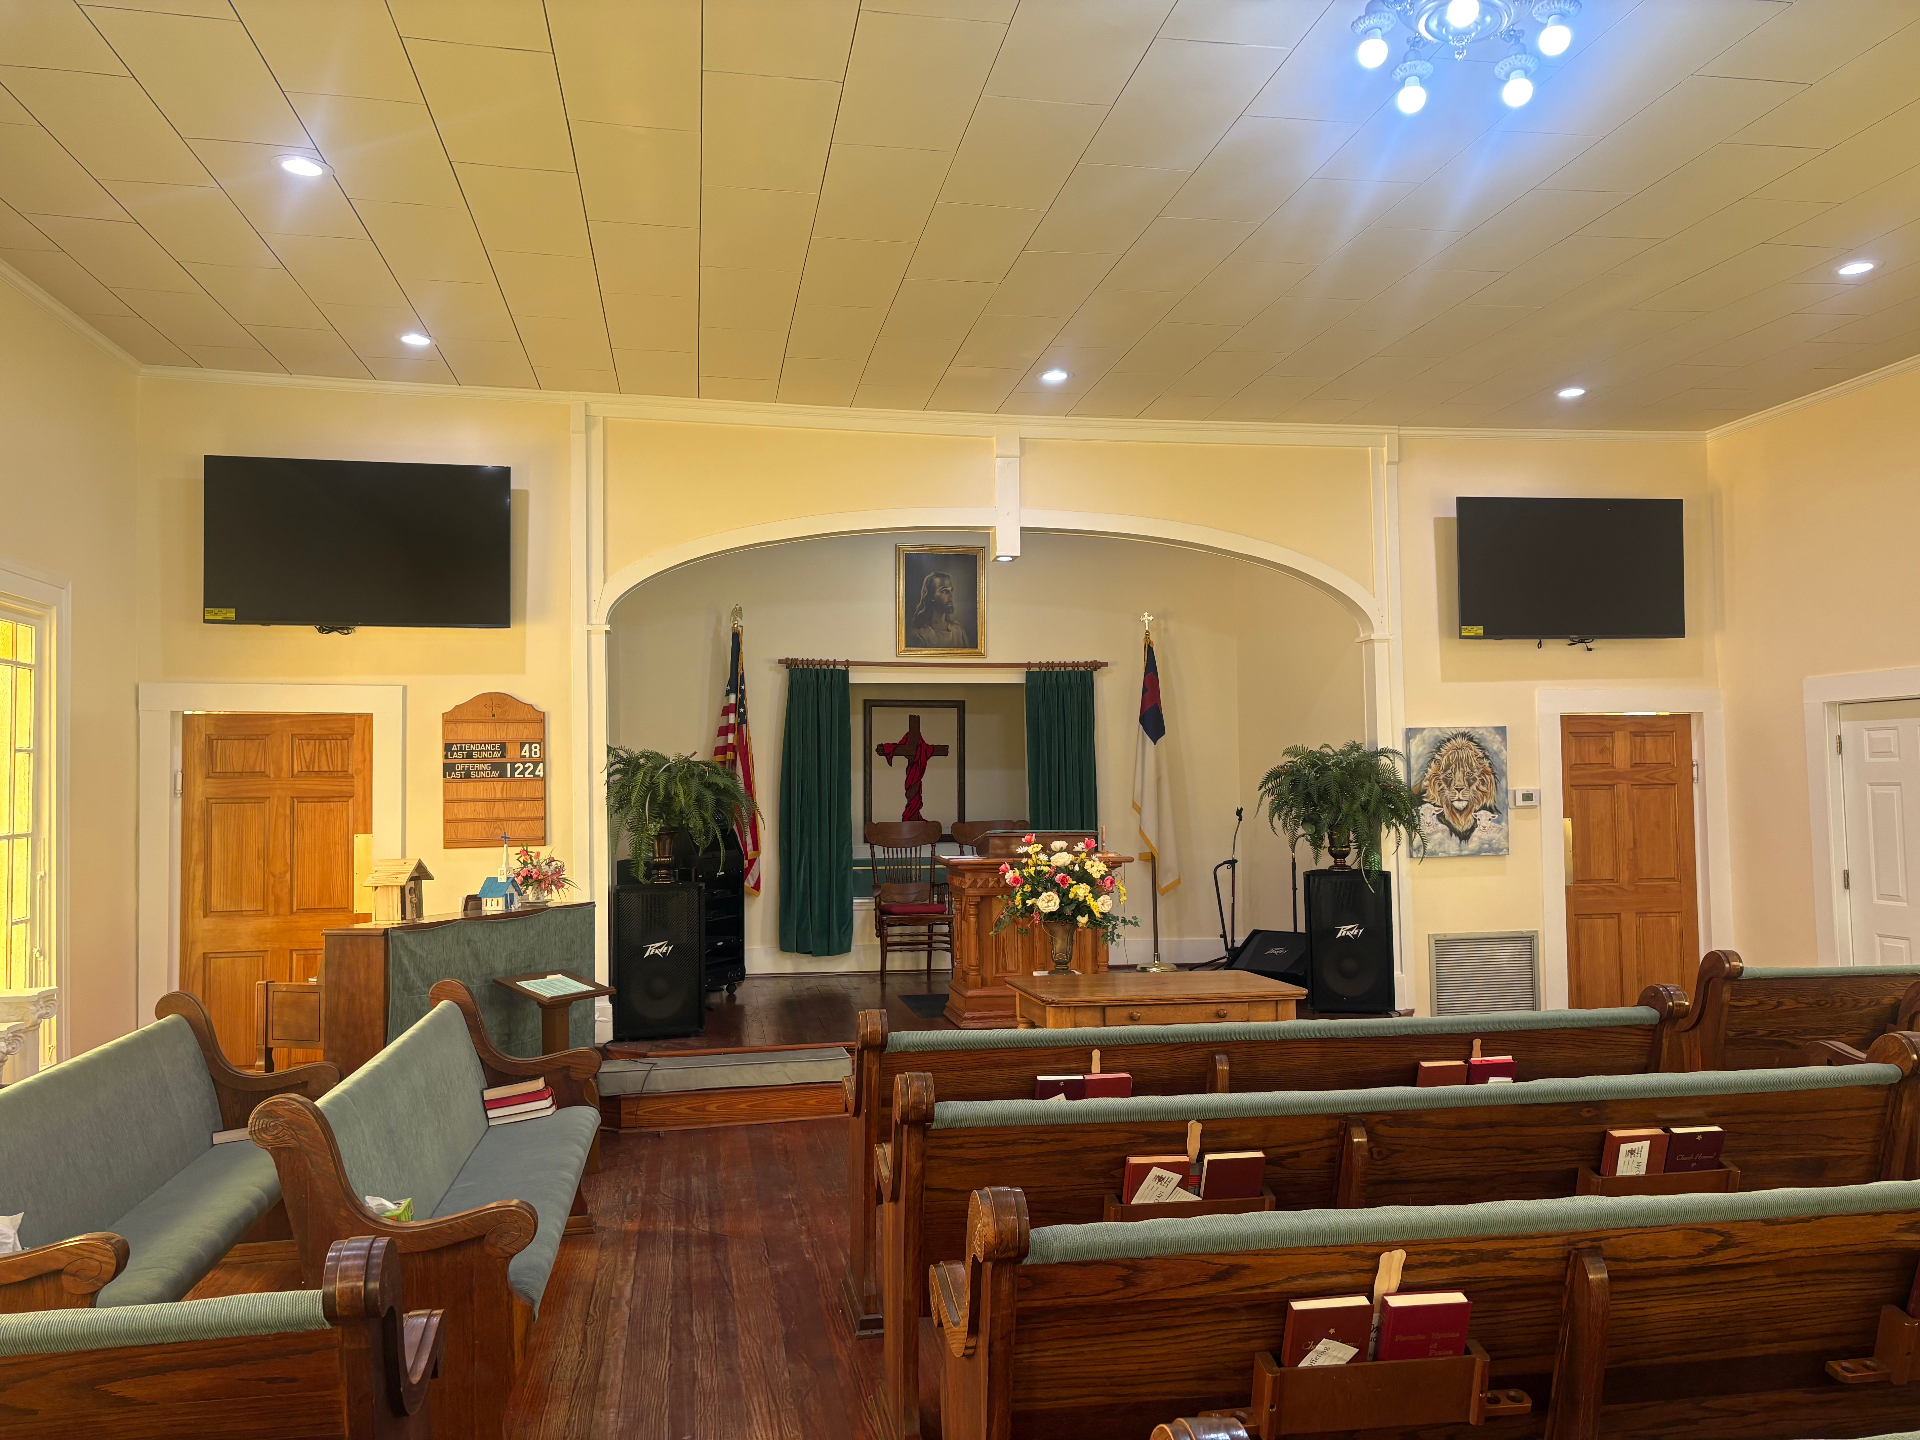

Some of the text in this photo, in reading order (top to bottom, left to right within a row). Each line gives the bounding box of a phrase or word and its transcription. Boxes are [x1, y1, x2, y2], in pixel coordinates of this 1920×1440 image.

[452, 743, 500, 751] ATTENDANCE
[521, 743, 540, 758] 48
[455, 763, 491, 771] OFFERING
[506, 762, 544, 778] 1224
[446, 771, 465, 779] LAST
[1395, 1332, 1460, 1342] Favorite Hymns
